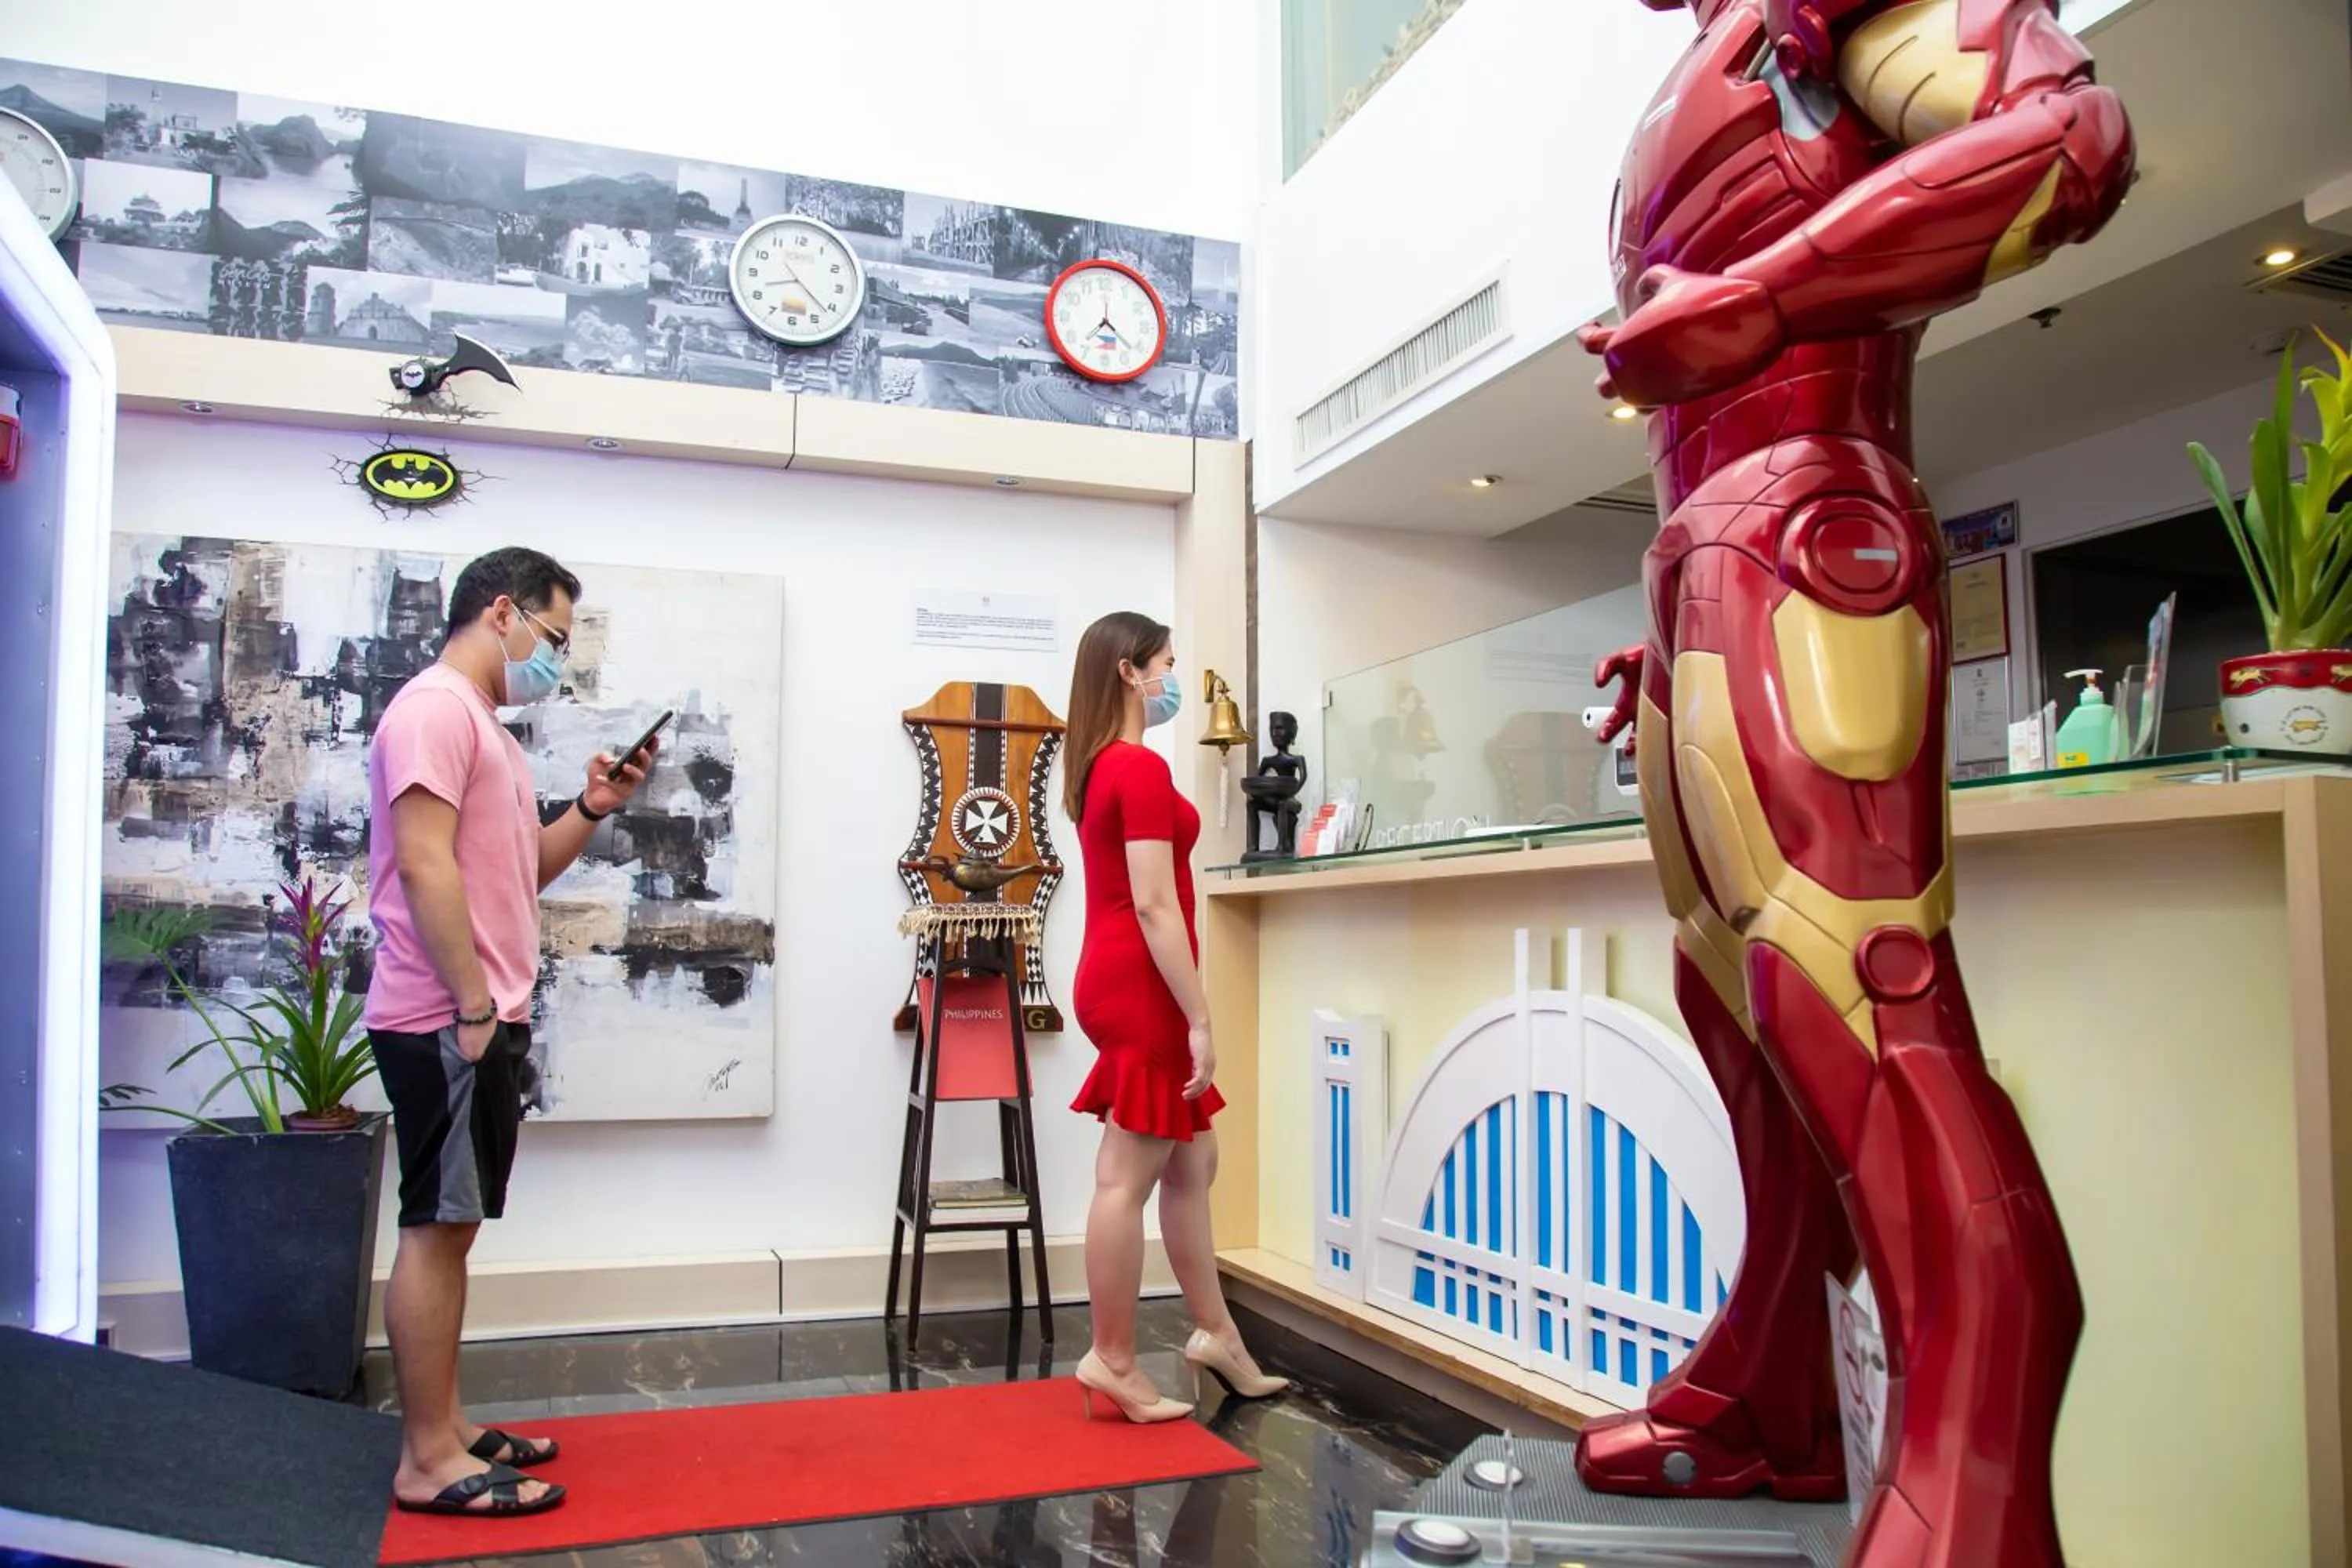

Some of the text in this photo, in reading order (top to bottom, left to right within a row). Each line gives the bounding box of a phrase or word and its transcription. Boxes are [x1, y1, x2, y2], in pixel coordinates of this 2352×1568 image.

[772, 238, 782, 248] 11
[795, 236, 808, 246] 12
[756, 250, 768, 260] 10
[820, 246, 824, 256] 1
[749, 267, 758, 277] 9
[830, 264, 840, 274] 2
[1096, 276, 1112, 292] 12
[753, 290, 763, 299] 8
[835, 285, 844, 294] 3
[768, 305, 778, 314] 7
[828, 303, 837, 312] 4
[788, 316, 797, 325] 6
[810, 314, 819, 323] 5
[944, 1009, 1004, 1019] PHILIPPINES
[1028, 1010, 1046, 1029] G
